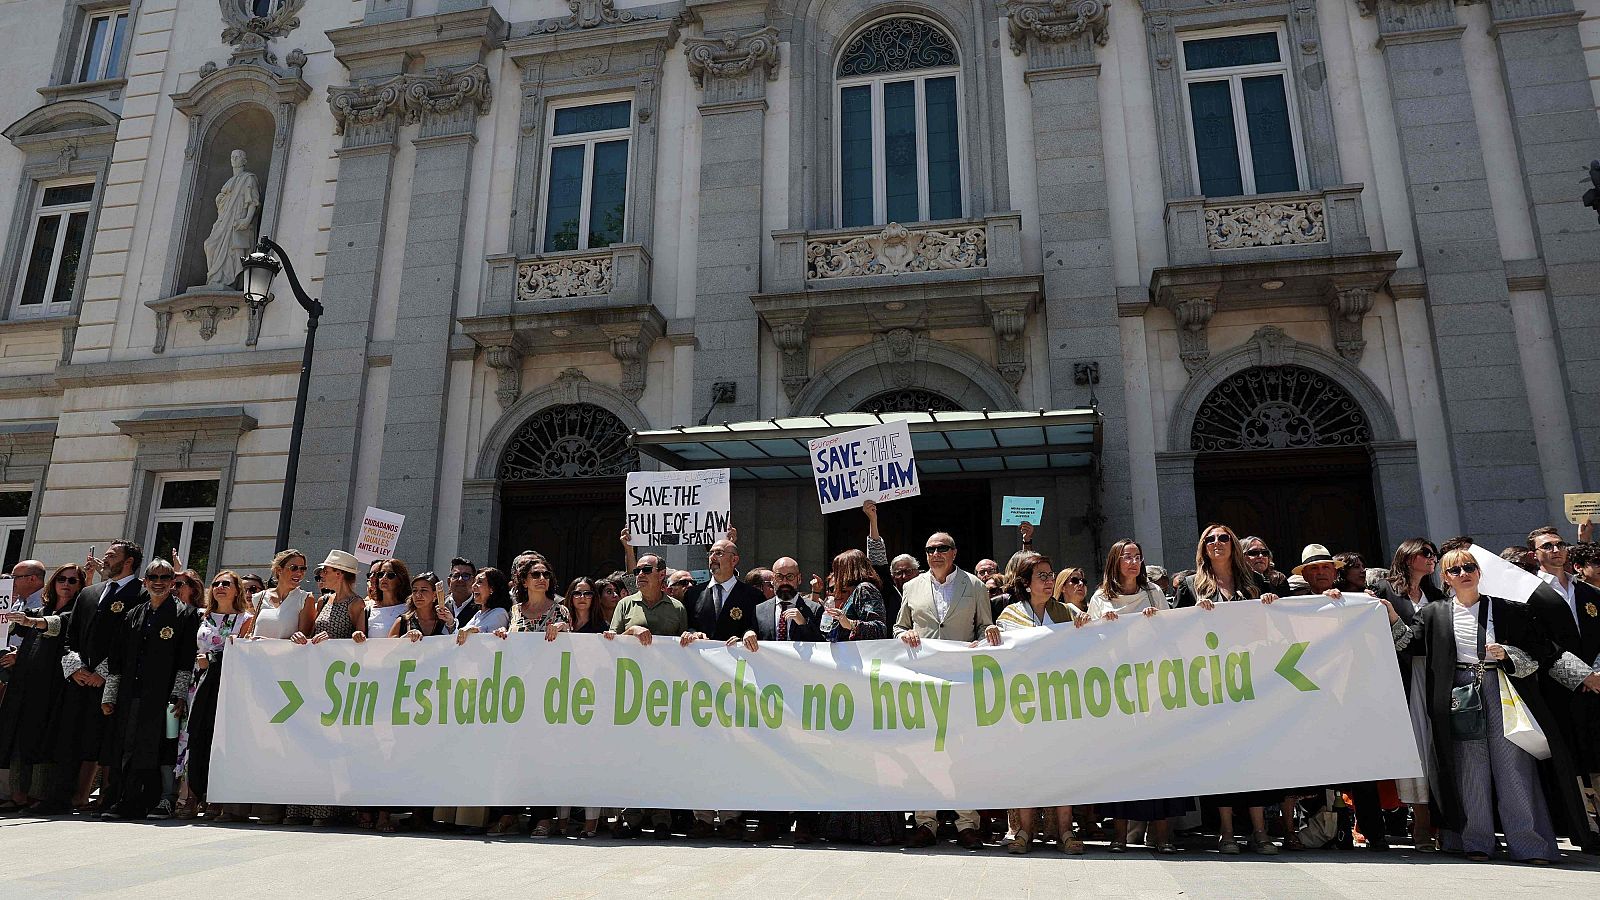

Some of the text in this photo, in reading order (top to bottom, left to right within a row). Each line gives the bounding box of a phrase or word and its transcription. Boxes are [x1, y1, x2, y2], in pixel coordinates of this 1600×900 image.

[816, 433, 902, 474] SAVE THE
[818, 458, 914, 504] RULE OF LAW
[628, 485, 702, 506] SAVE THE
[364, 518, 399, 532] CIUDADANOS
[628, 511, 730, 534] RULE OF LAW
[358, 543, 372, 551] ANTE
[380, 547, 391, 556] LEY
[364, 535, 389, 547] IGUALES
[649, 532, 716, 546] IN SPAIN
[320, 631, 1256, 752] Sin Estado de Derecho no hay Democracia
